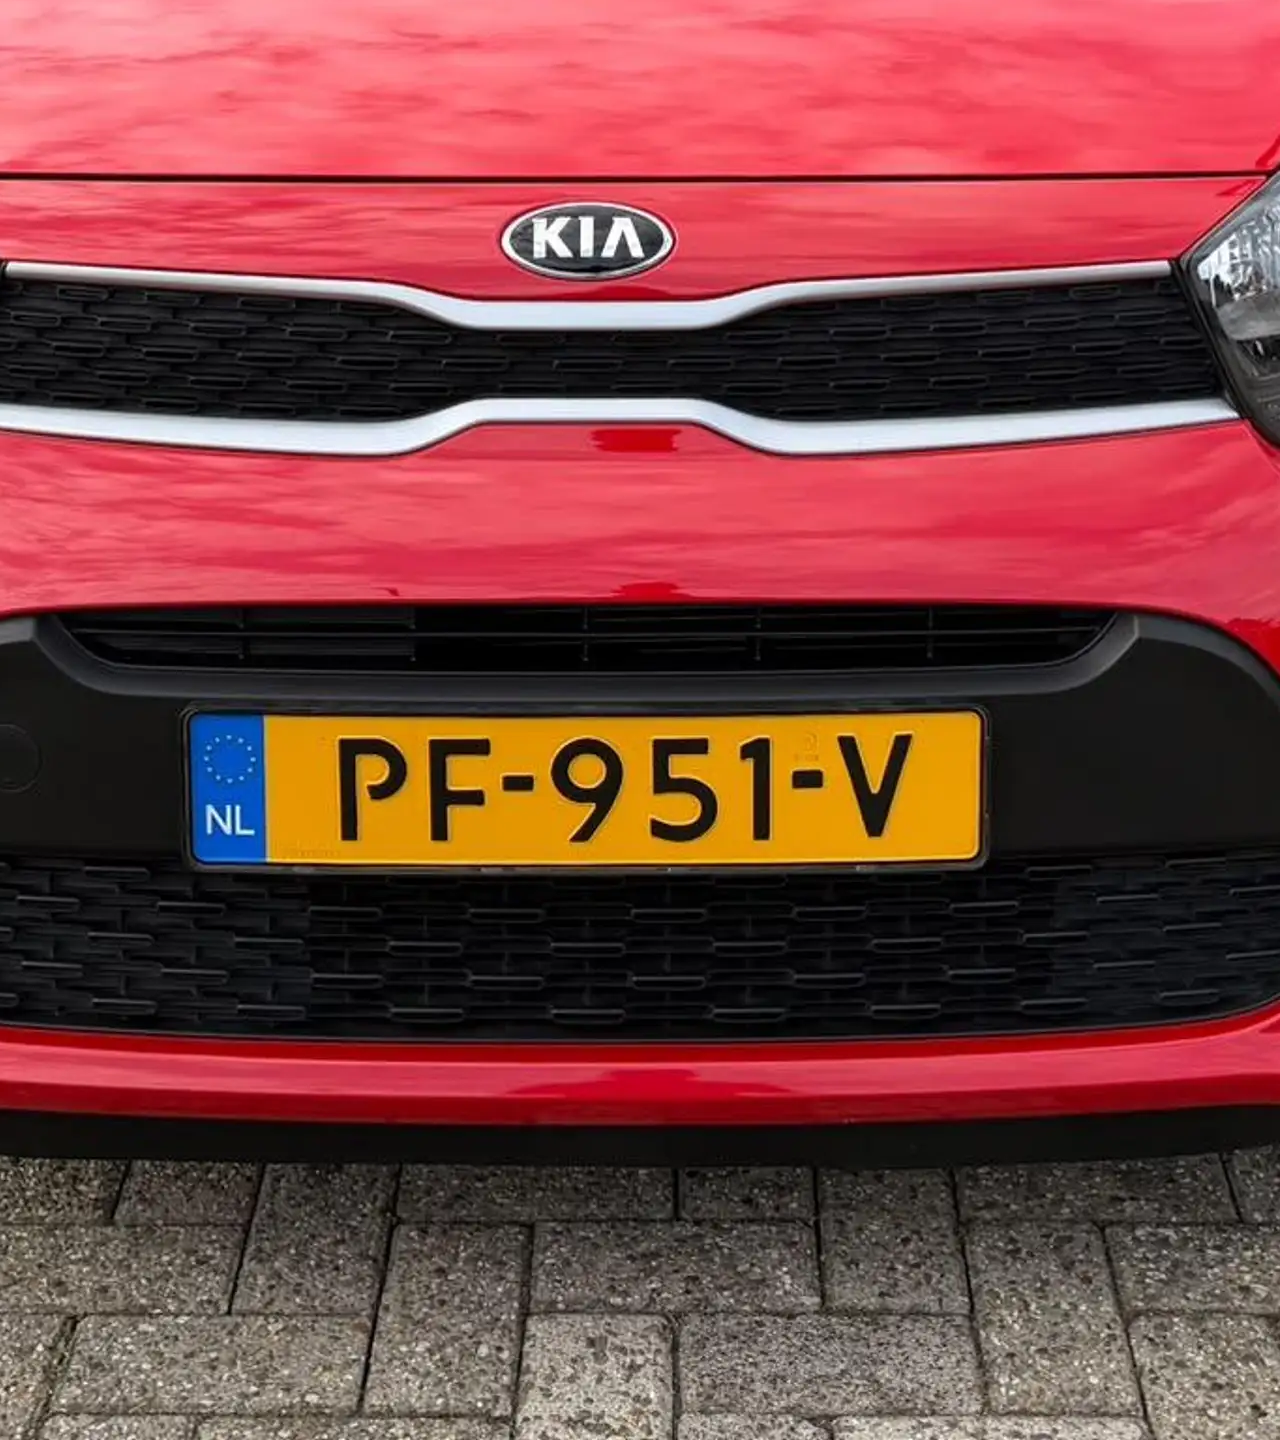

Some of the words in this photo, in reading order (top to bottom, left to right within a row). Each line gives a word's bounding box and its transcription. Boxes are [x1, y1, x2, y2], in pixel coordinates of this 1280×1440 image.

[532, 216, 645, 258] KIA
[339, 734, 912, 842] PF-951-V
[207, 805, 254, 834] NL
